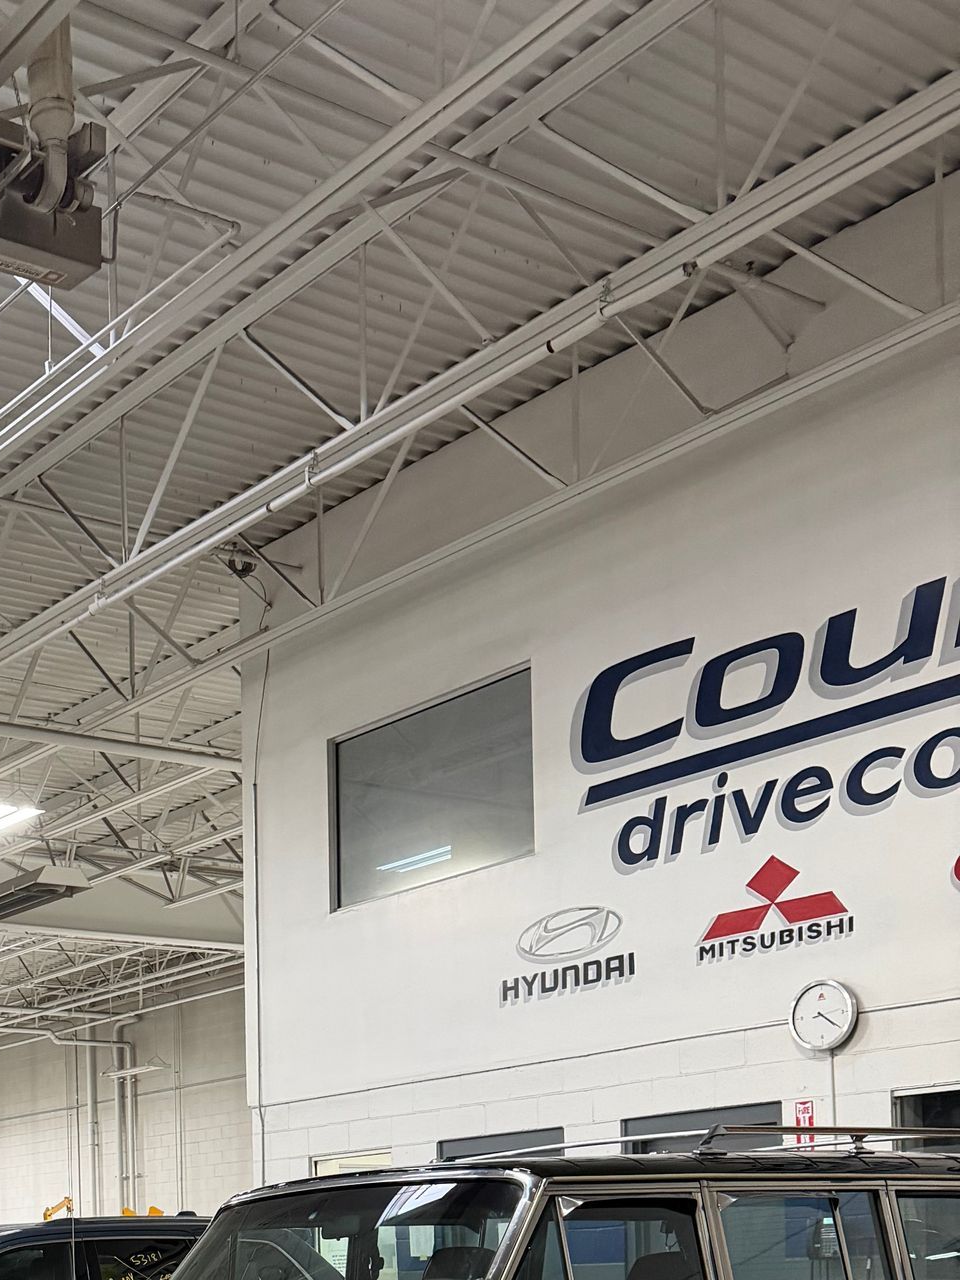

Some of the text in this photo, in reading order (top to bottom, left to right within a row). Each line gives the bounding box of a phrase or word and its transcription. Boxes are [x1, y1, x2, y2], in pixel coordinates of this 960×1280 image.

[574, 576, 960, 770] Cou
[697, 916, 855, 963] MITSUBISHI
[500, 952, 636, 1003] HYUNDAI
